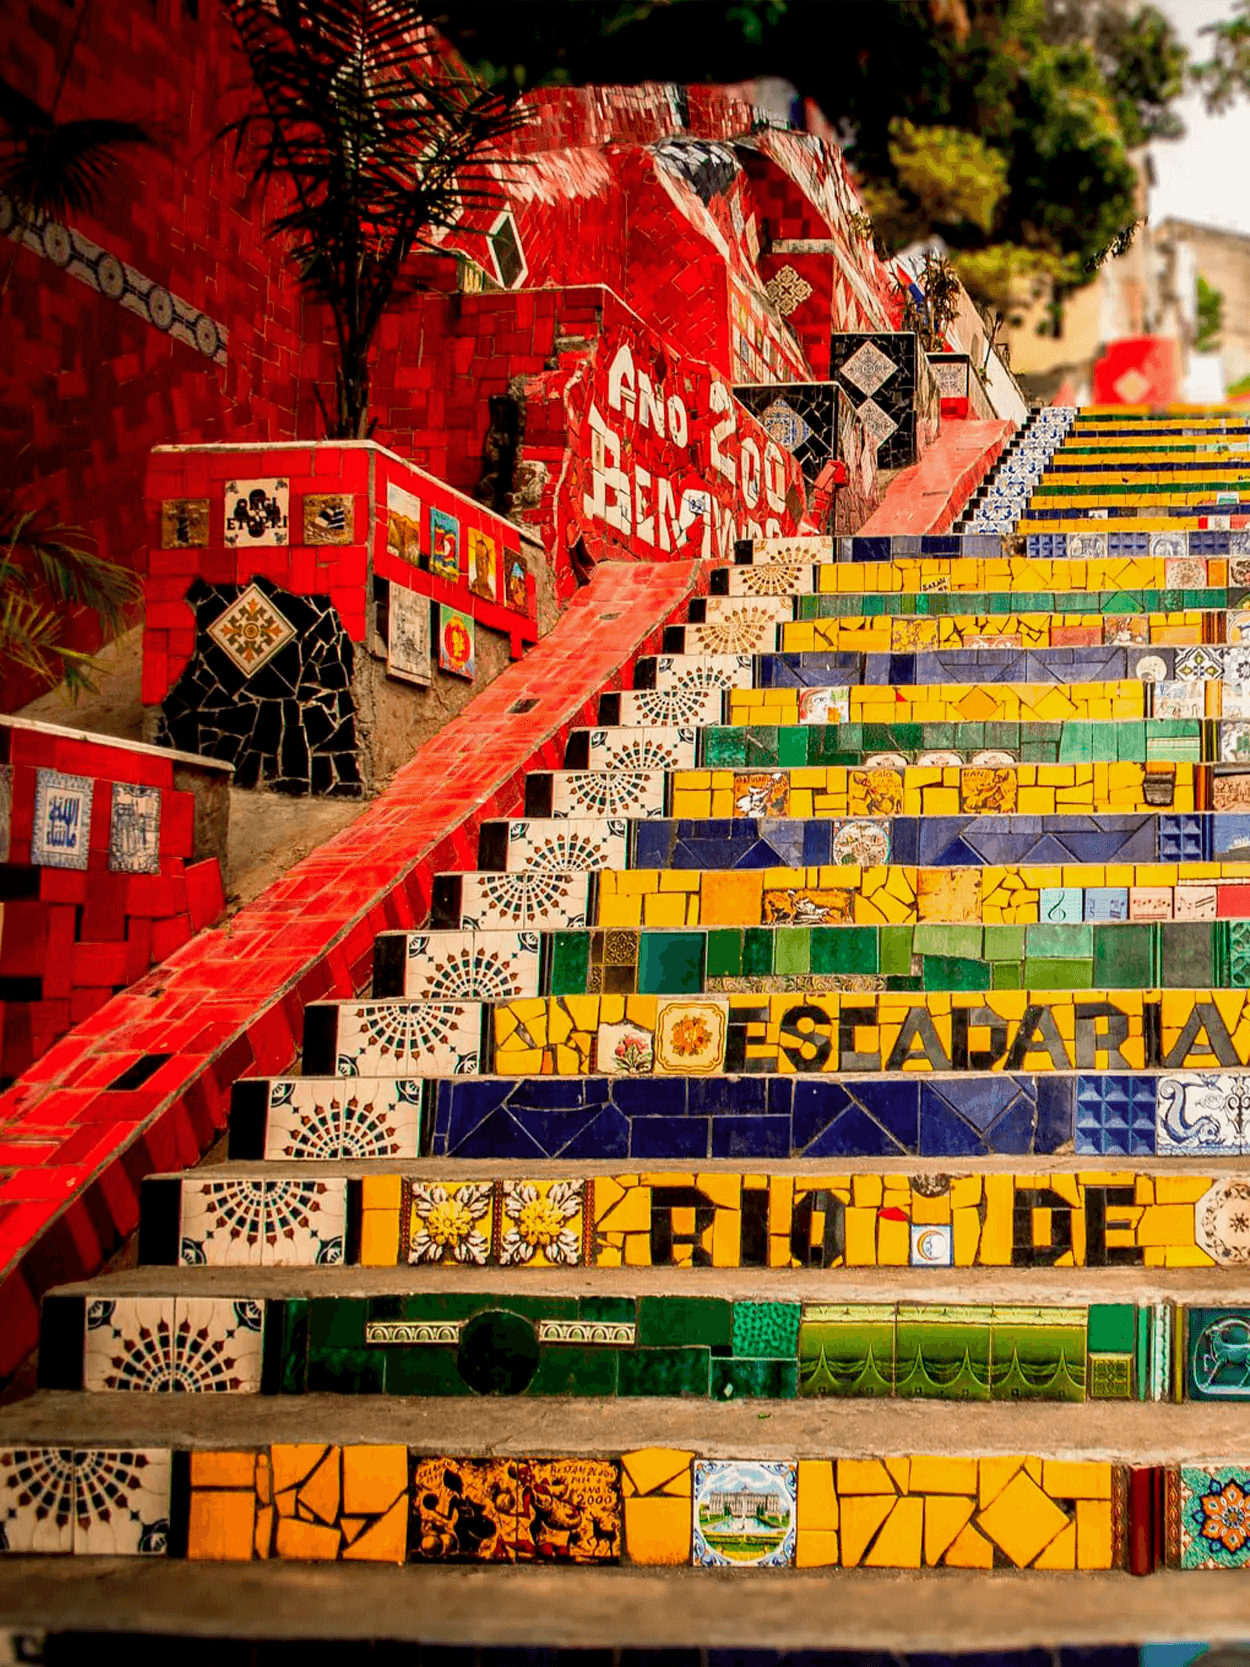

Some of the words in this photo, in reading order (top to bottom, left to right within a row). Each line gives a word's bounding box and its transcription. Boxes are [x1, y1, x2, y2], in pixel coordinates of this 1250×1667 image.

[608, 344, 688, 448] ANO
[727, 999, 1240, 1073] ESCADARIA
[650, 1186, 847, 1268] RIO
[1012, 1186, 1144, 1267] DE
